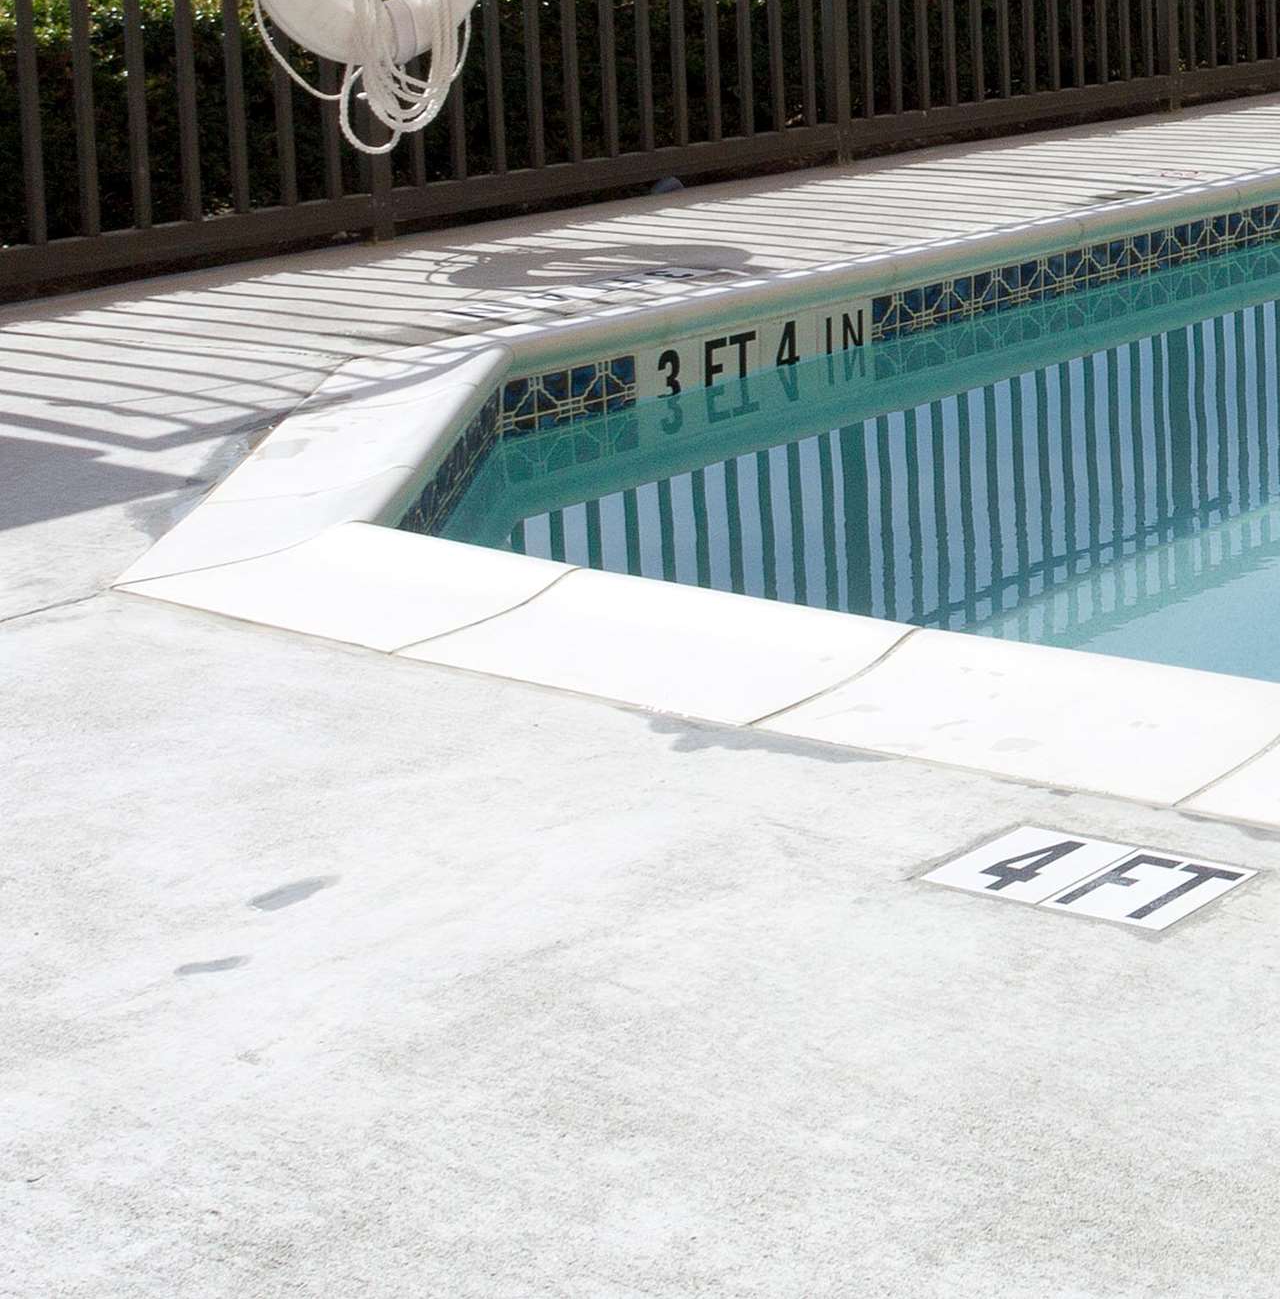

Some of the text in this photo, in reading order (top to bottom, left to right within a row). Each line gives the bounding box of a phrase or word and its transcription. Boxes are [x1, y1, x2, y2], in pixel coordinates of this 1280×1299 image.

[657, 308, 864, 398] 3 FT 4 IN
[979, 840, 1247, 920] 4 FT
